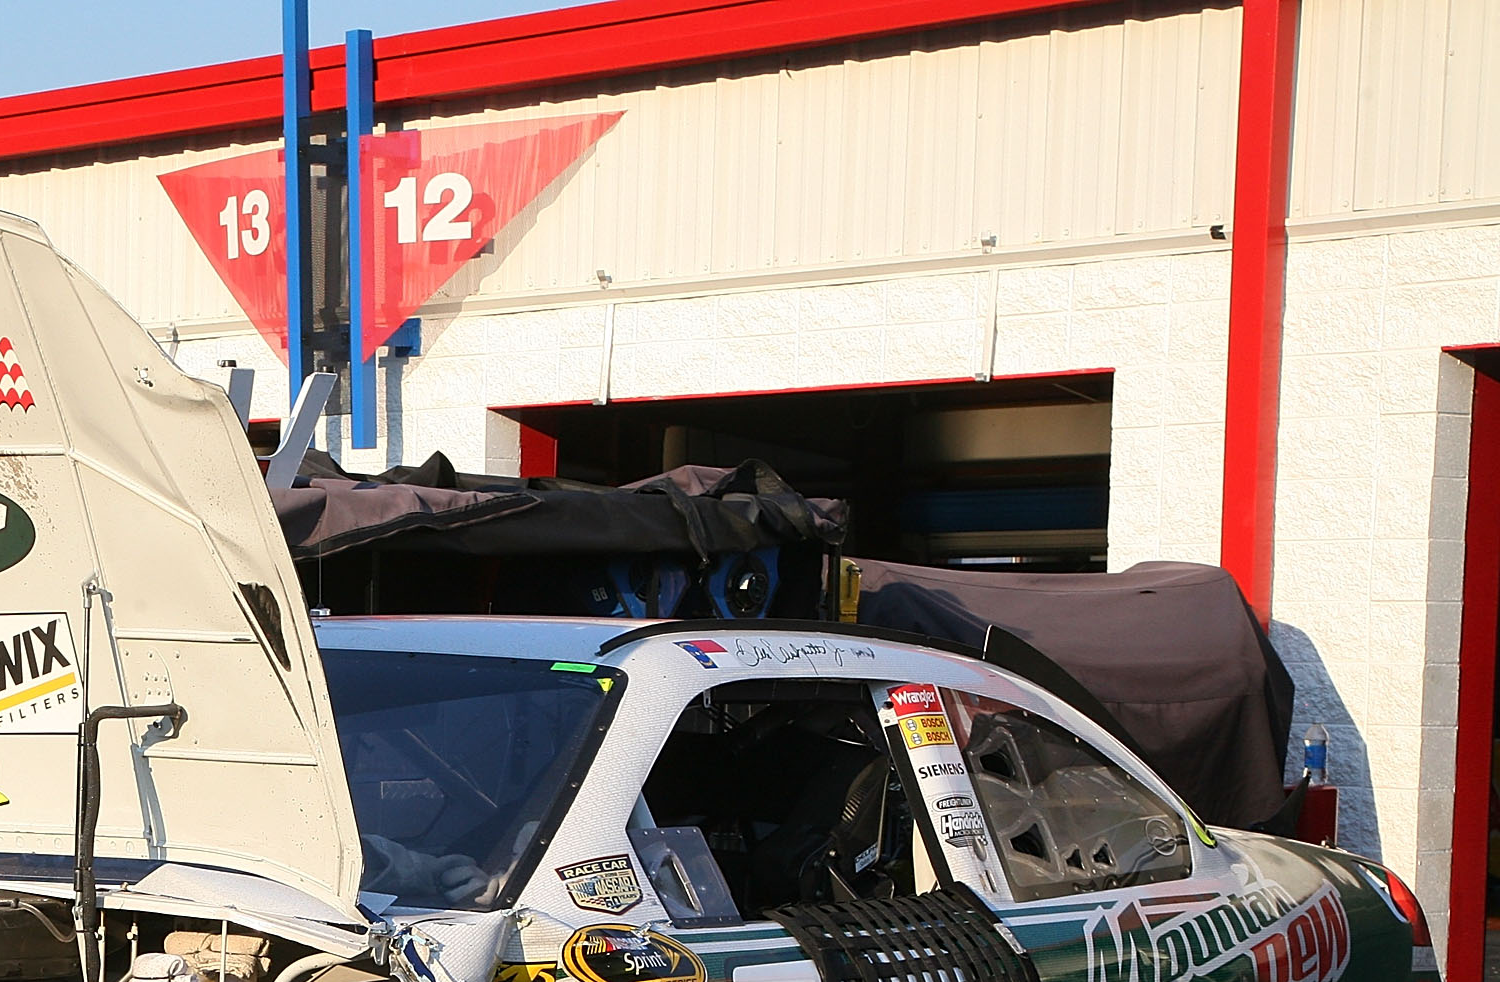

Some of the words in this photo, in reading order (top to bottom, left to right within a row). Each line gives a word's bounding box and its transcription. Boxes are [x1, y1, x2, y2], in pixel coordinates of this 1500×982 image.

[384, 172, 473, 244] 12
[219, 189, 271, 260] 13
[892, 689, 936, 709] Wrangler
[920, 717, 946, 729] BOSCH
[925, 731, 951, 742] BOSCH
[918, 762, 965, 780] SIEMENS
[941, 812, 984, 838] Hendrick
[563, 864, 602, 880] RACE
[602, 858, 628, 870] CAR
[623, 949, 668, 976] Sprint
